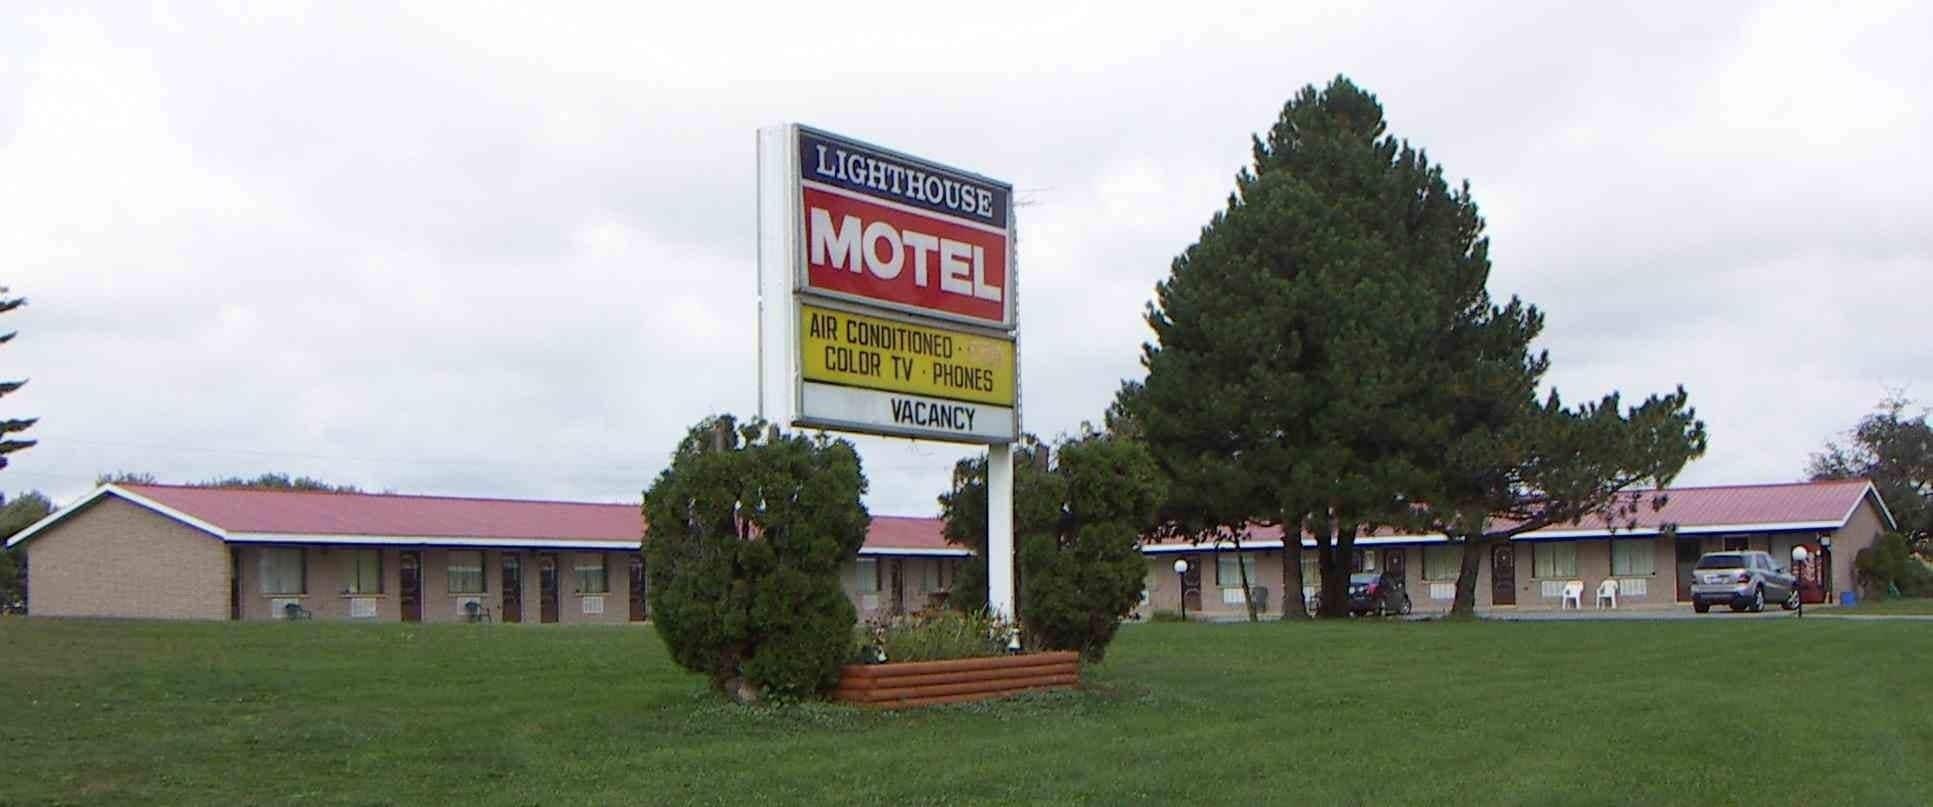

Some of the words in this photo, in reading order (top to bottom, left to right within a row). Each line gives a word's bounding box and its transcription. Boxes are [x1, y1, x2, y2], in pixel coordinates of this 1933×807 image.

[816, 145, 993, 218] LIGHTHOUSE
[810, 207, 1001, 302] MOTEL
[810, 313, 837, 341] AIR
[846, 319, 953, 359] CONDITIONED
[825, 346, 881, 378] COLOR
[891, 355, 913, 382] TV
[933, 362, 993, 392] PHONES
[890, 398, 976, 431] VACANCY
